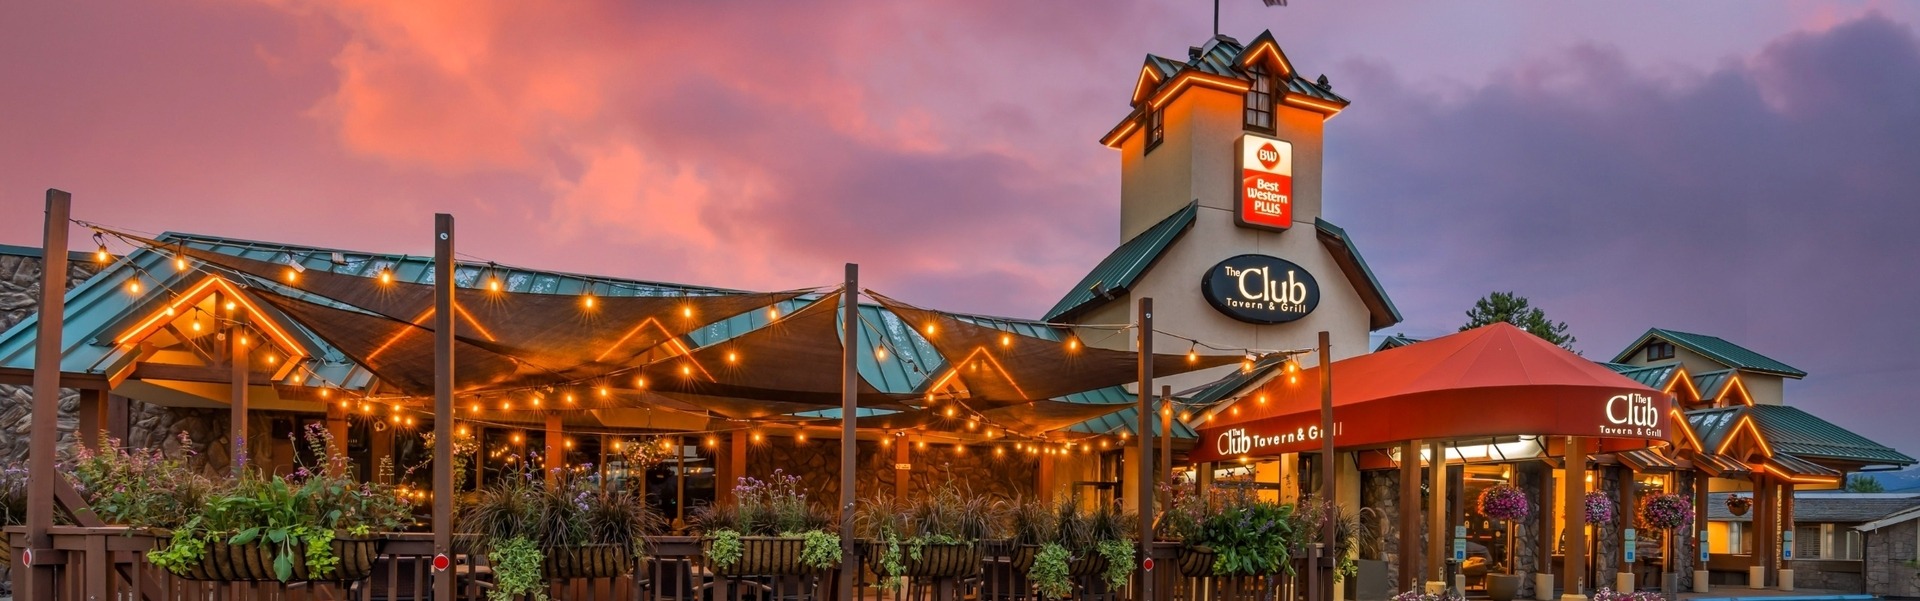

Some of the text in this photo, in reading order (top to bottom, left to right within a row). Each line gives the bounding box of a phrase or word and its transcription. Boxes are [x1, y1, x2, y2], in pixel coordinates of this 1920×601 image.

[1259, 149, 1277, 162] BW
[1257, 178, 1279, 192] Best
[1247, 187, 1288, 204] Western
[1225, 266, 1307, 304] The Club
[1226, 298, 1306, 313] Tavern & Grill
[1634, 393, 1646, 404] The
[1606, 392, 1658, 428] Club
[1232, 428, 1240, 437] The
[1599, 425, 1662, 438] Tavern & Grill
[1217, 428, 1251, 456] Club
[1253, 432, 1294, 448] Tavern
[1297, 427, 1305, 441] &
